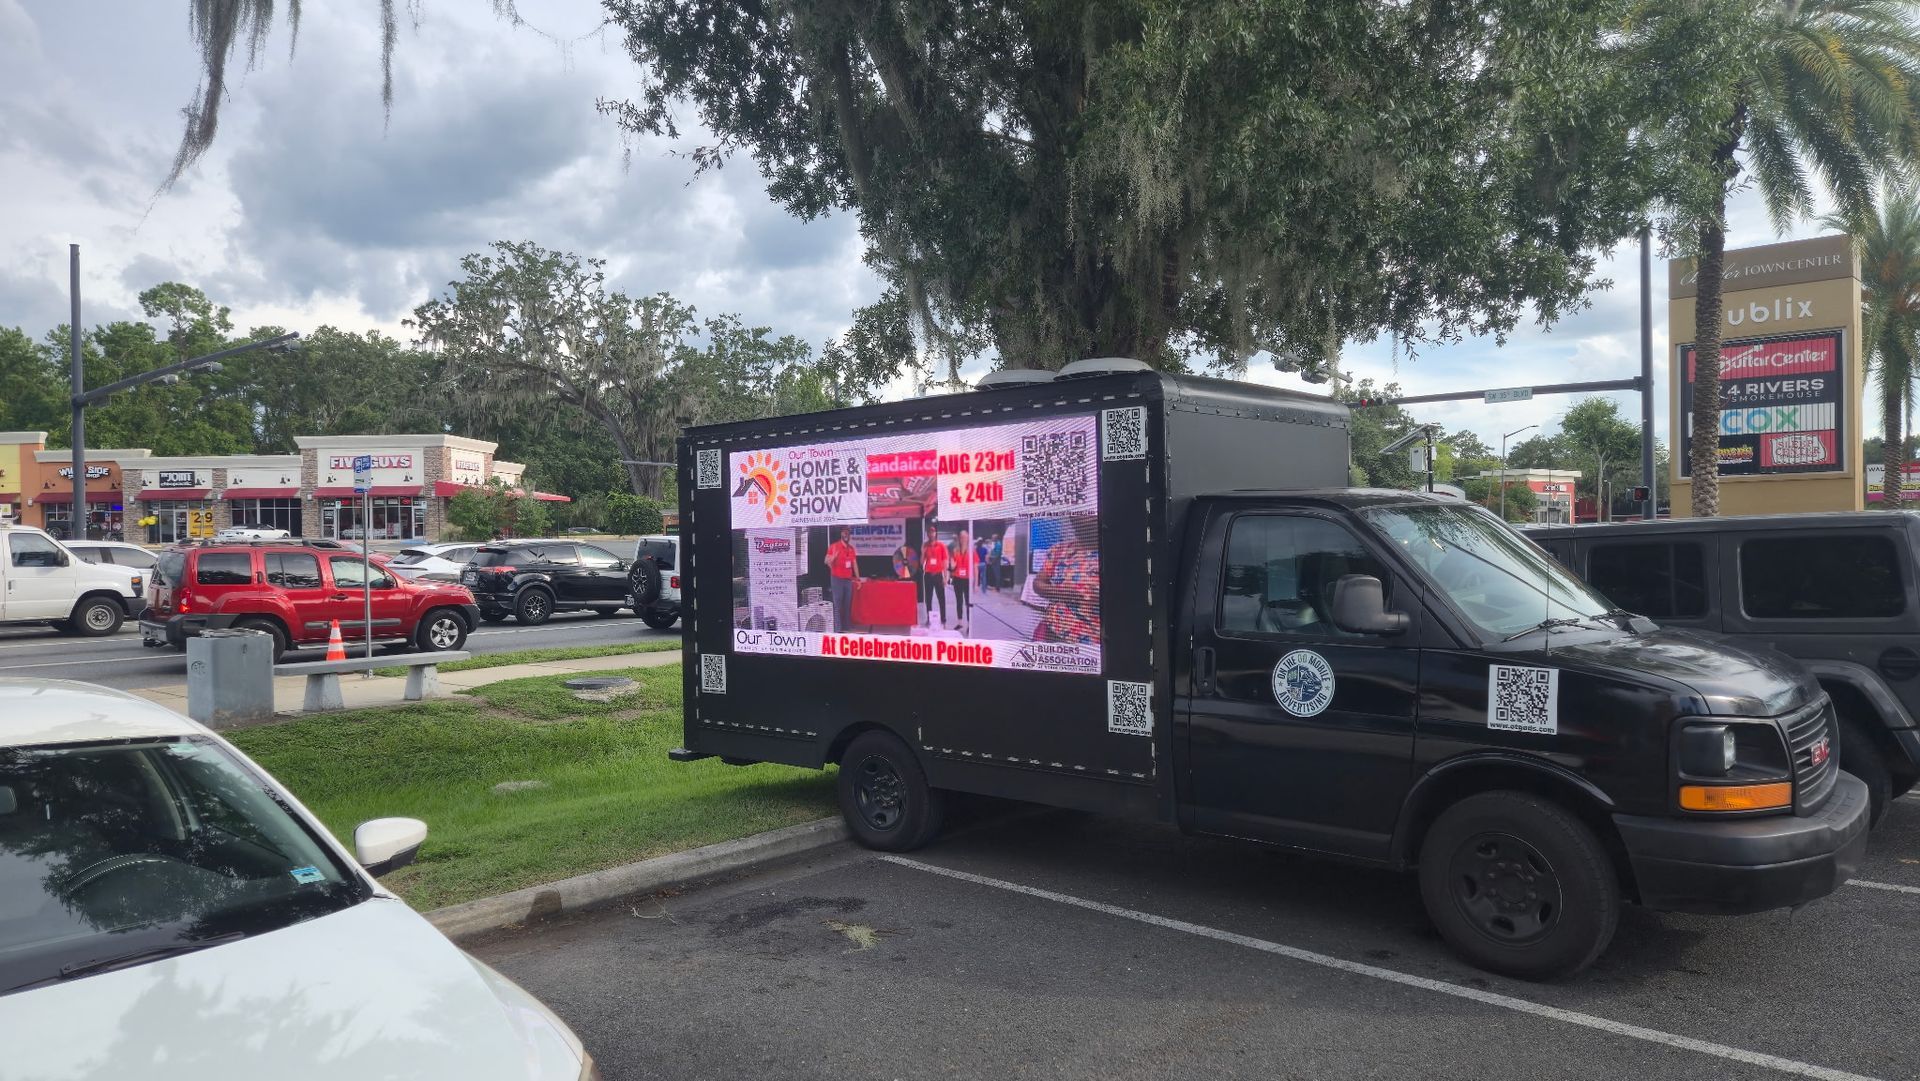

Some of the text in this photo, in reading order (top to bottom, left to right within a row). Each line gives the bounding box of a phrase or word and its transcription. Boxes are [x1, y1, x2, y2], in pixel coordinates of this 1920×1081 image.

[1727, 297, 1813, 326] ublix
[1771, 350, 1827, 367] Center
[1513, 390, 1529, 398] BLVD
[1728, 378, 1825, 396] 4 RIVERS
[1731, 390, 1821, 403] SMOKEHOUSE
[1721, 406, 1799, 433] COX
[789, 449, 834, 459] Our Town
[330, 456, 355, 469] FIV
[371, 456, 410, 468] GUYS
[789, 457, 860, 479] HOME &
[938, 450, 1015, 475] AUG 23rd
[59, 466, 109, 476] WI SIDE
[167, 472, 193, 482] JOINT
[789, 475, 863, 497] GARDEN
[950, 481, 1003, 503] & 24th
[789, 496, 842, 515] SHOW
[736, 631, 807, 647] Our Town
[822, 635, 993, 665] At Celebration Pointe
[1037, 645, 1080, 655] BUILDERS
[1038, 655, 1098, 666] ASSOCIATION
[1282, 655, 1297, 670] THE
[1308, 655, 1331, 682] MOBILE
[1277, 667, 1288, 680] ON
[1279, 692, 1327, 713] ADVERTISING
[1490, 722, 1555, 733] www.otgads.com
